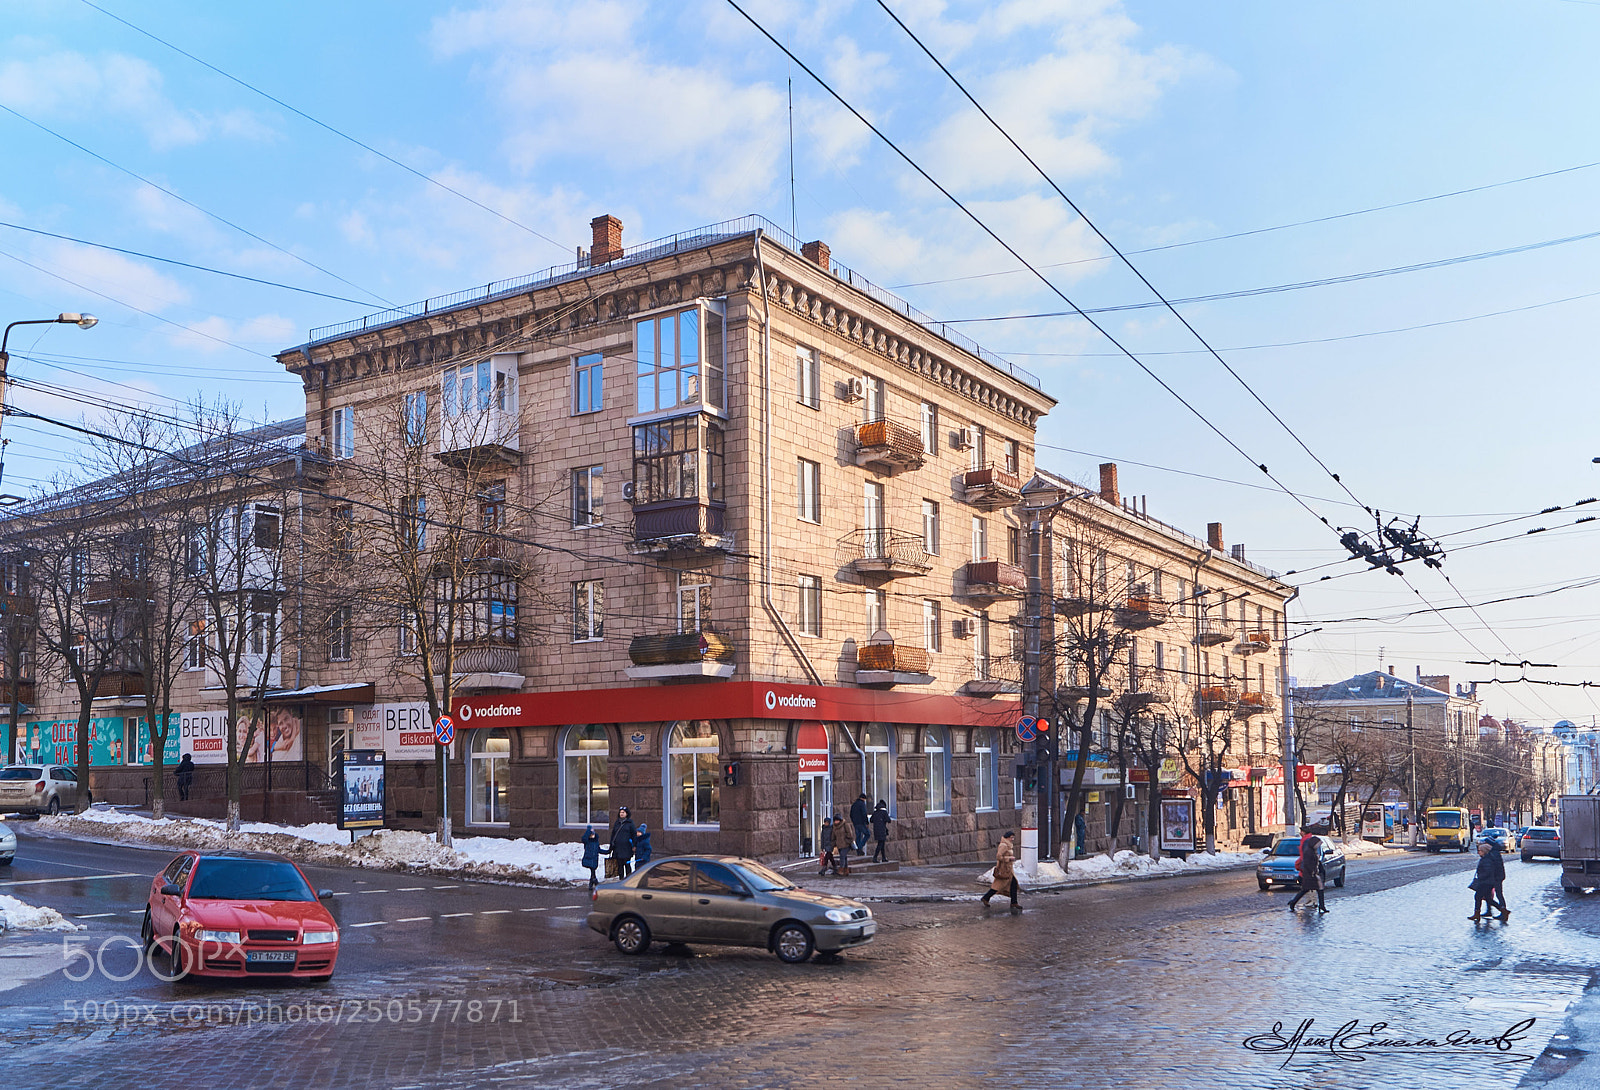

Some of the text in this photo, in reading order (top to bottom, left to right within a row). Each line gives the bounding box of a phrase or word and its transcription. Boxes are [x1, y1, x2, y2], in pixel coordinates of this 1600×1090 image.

[777, 693, 817, 708] vodafone
[361, 709, 381, 720] ОДЯГ
[474, 704, 522, 717] vodafone
[386, 708, 431, 731] BERL
[356, 722, 381, 732] ВЗУТТЯ
[194, 740, 222, 750] diskont
[401, 734, 435, 744] diskont
[55, 743, 94, 765] НА ВС
